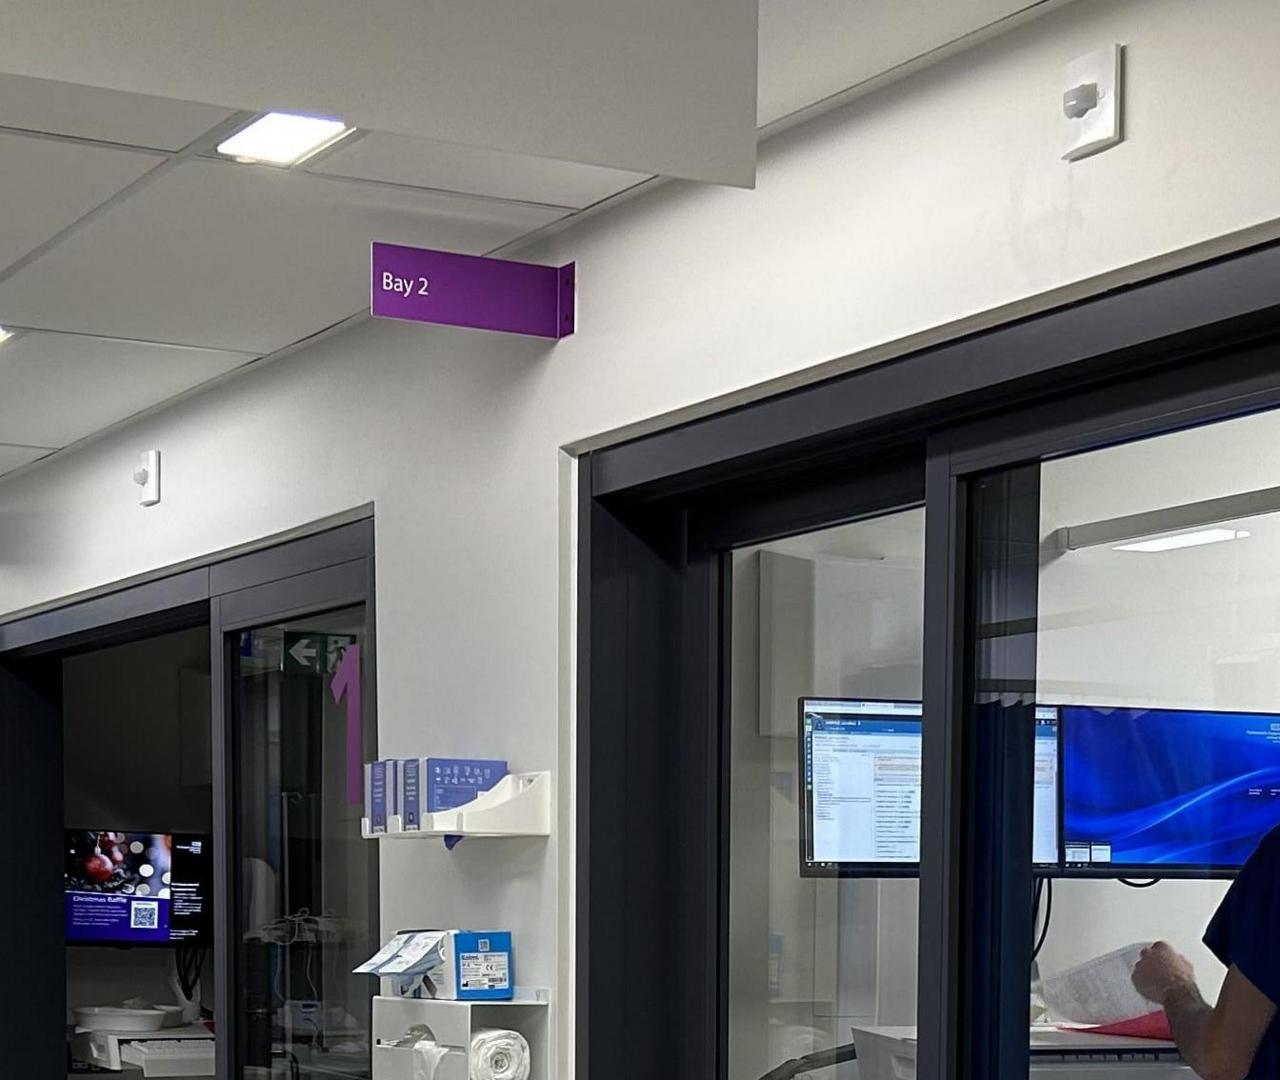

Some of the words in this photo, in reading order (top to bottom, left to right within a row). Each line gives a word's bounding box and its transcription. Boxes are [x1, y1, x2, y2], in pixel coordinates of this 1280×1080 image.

[382, 271, 413, 298] Bay
[417, 277, 429, 296] 2
[329, 643, 363, 805] 1
